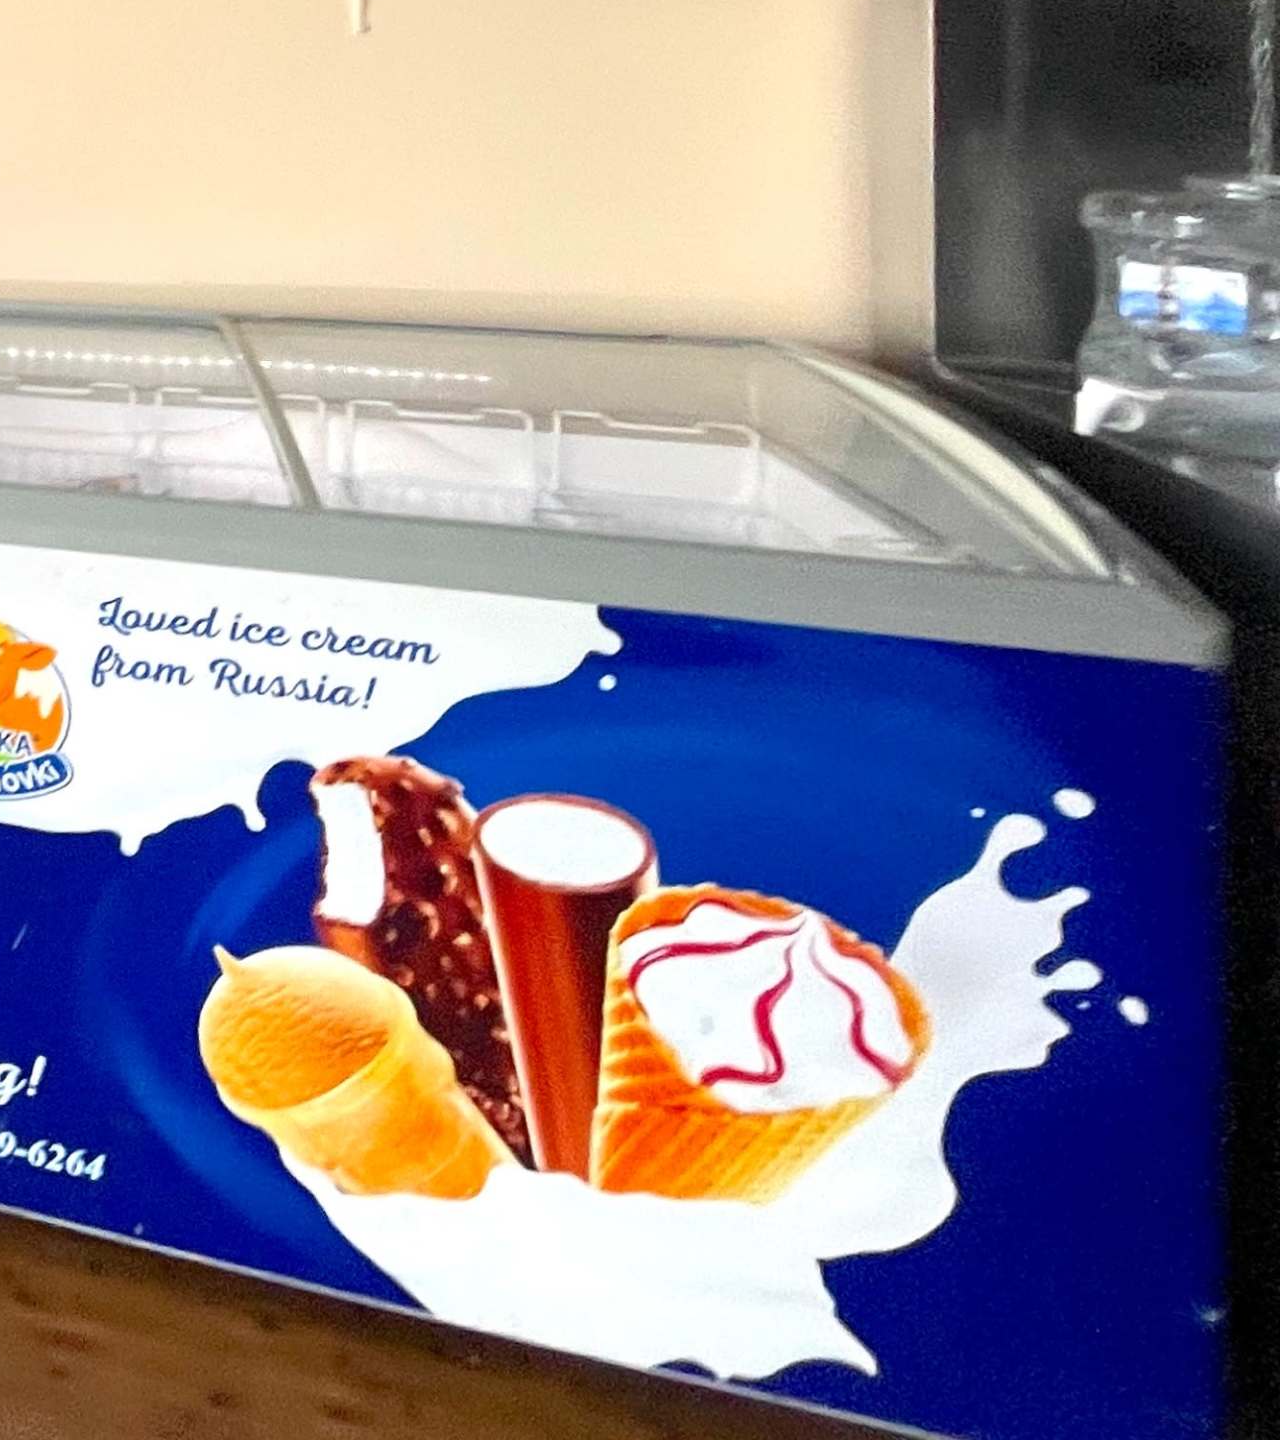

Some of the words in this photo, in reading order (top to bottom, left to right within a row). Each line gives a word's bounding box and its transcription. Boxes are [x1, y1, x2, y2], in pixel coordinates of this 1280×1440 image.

[98, 596, 221, 640] Loved
[230, 613, 290, 647] ice
[301, 627, 440, 665] cream
[92, 644, 193, 688] from
[209, 658, 377, 709] Russia!
